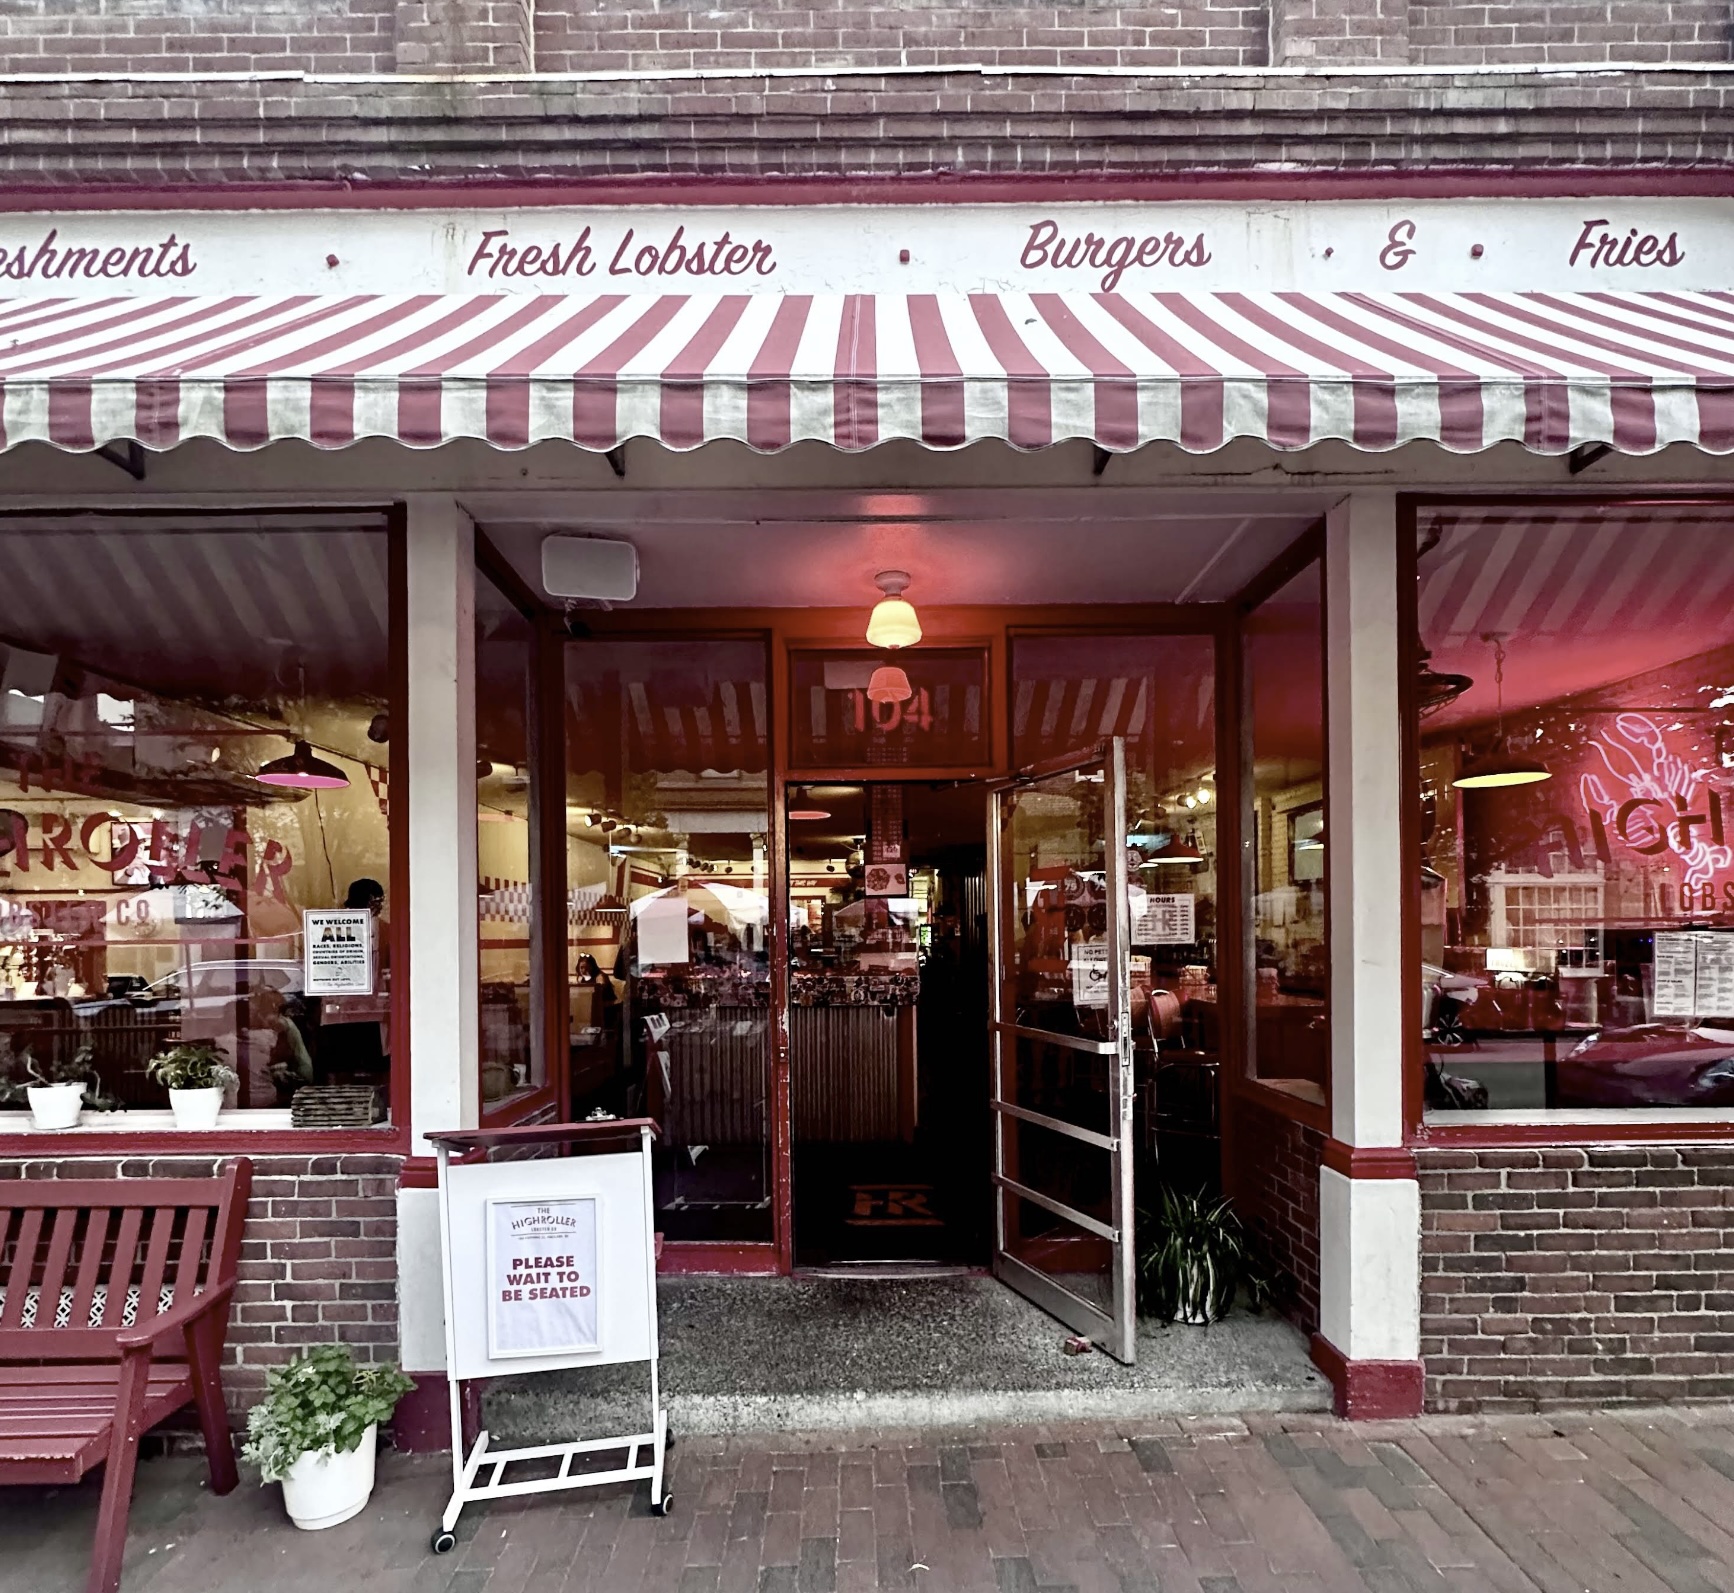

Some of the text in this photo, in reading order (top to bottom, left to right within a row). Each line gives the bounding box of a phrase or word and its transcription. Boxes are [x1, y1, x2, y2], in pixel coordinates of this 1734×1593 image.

[468, 225, 778, 278] Fresh Lobster
[1379, 220, 1417, 270] &
[1569, 218, 1685, 269] Fries
[1020, 219, 1212, 292] Burgers
[321, 926, 356, 942] ALL
[536, 1207, 551, 1215] THE
[511, 1215, 577, 1230] HIGHROLLER
[512, 1255, 575, 1270] PLEASE
[506, 1271, 580, 1286] WAIT TO
[501, 1285, 591, 1302] BE SEATED
